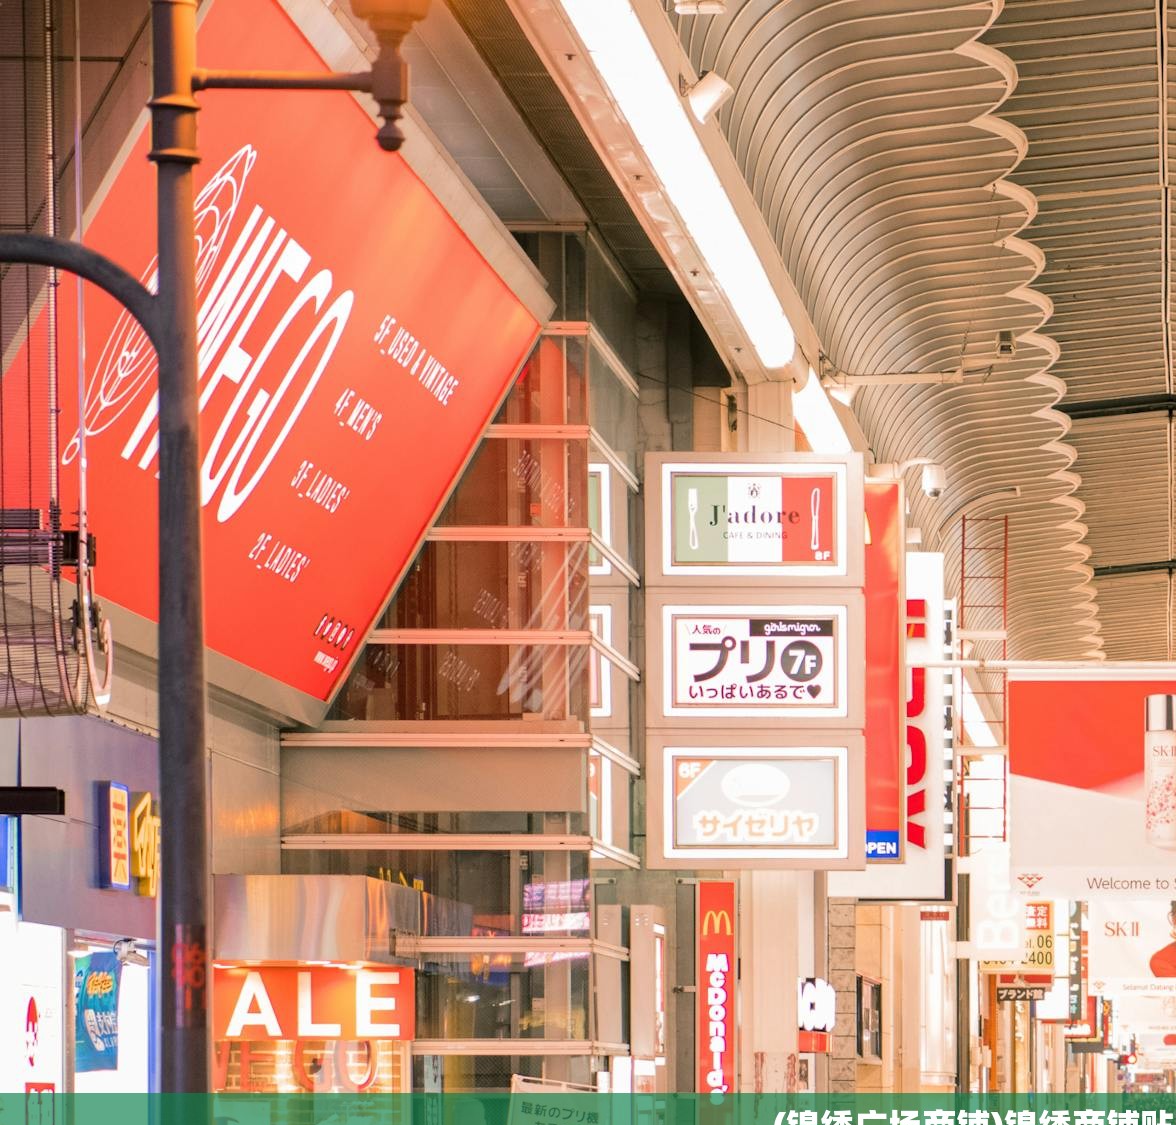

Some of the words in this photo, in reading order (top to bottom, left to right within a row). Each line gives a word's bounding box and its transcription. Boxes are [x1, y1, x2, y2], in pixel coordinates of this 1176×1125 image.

[418, 355, 459, 407] VINTAGE
[709, 504, 800, 526] J'adore
[756, 531, 788, 539] DINING
[692, 624, 721, 635] 人気の
[689, 636, 776, 683] プリ
[788, 649, 817, 675] 7F
[689, 684, 806, 699] いっぱいあるで
[866, 841, 897, 855] PEN
[1086, 877, 1151, 890] Welcome
[1156, 879, 1169, 890] to
[1037, 934, 1053, 949] 06
[705, 953, 728, 1106] McDonald's
[520, 1101, 599, 1124] 最新のプリ機
